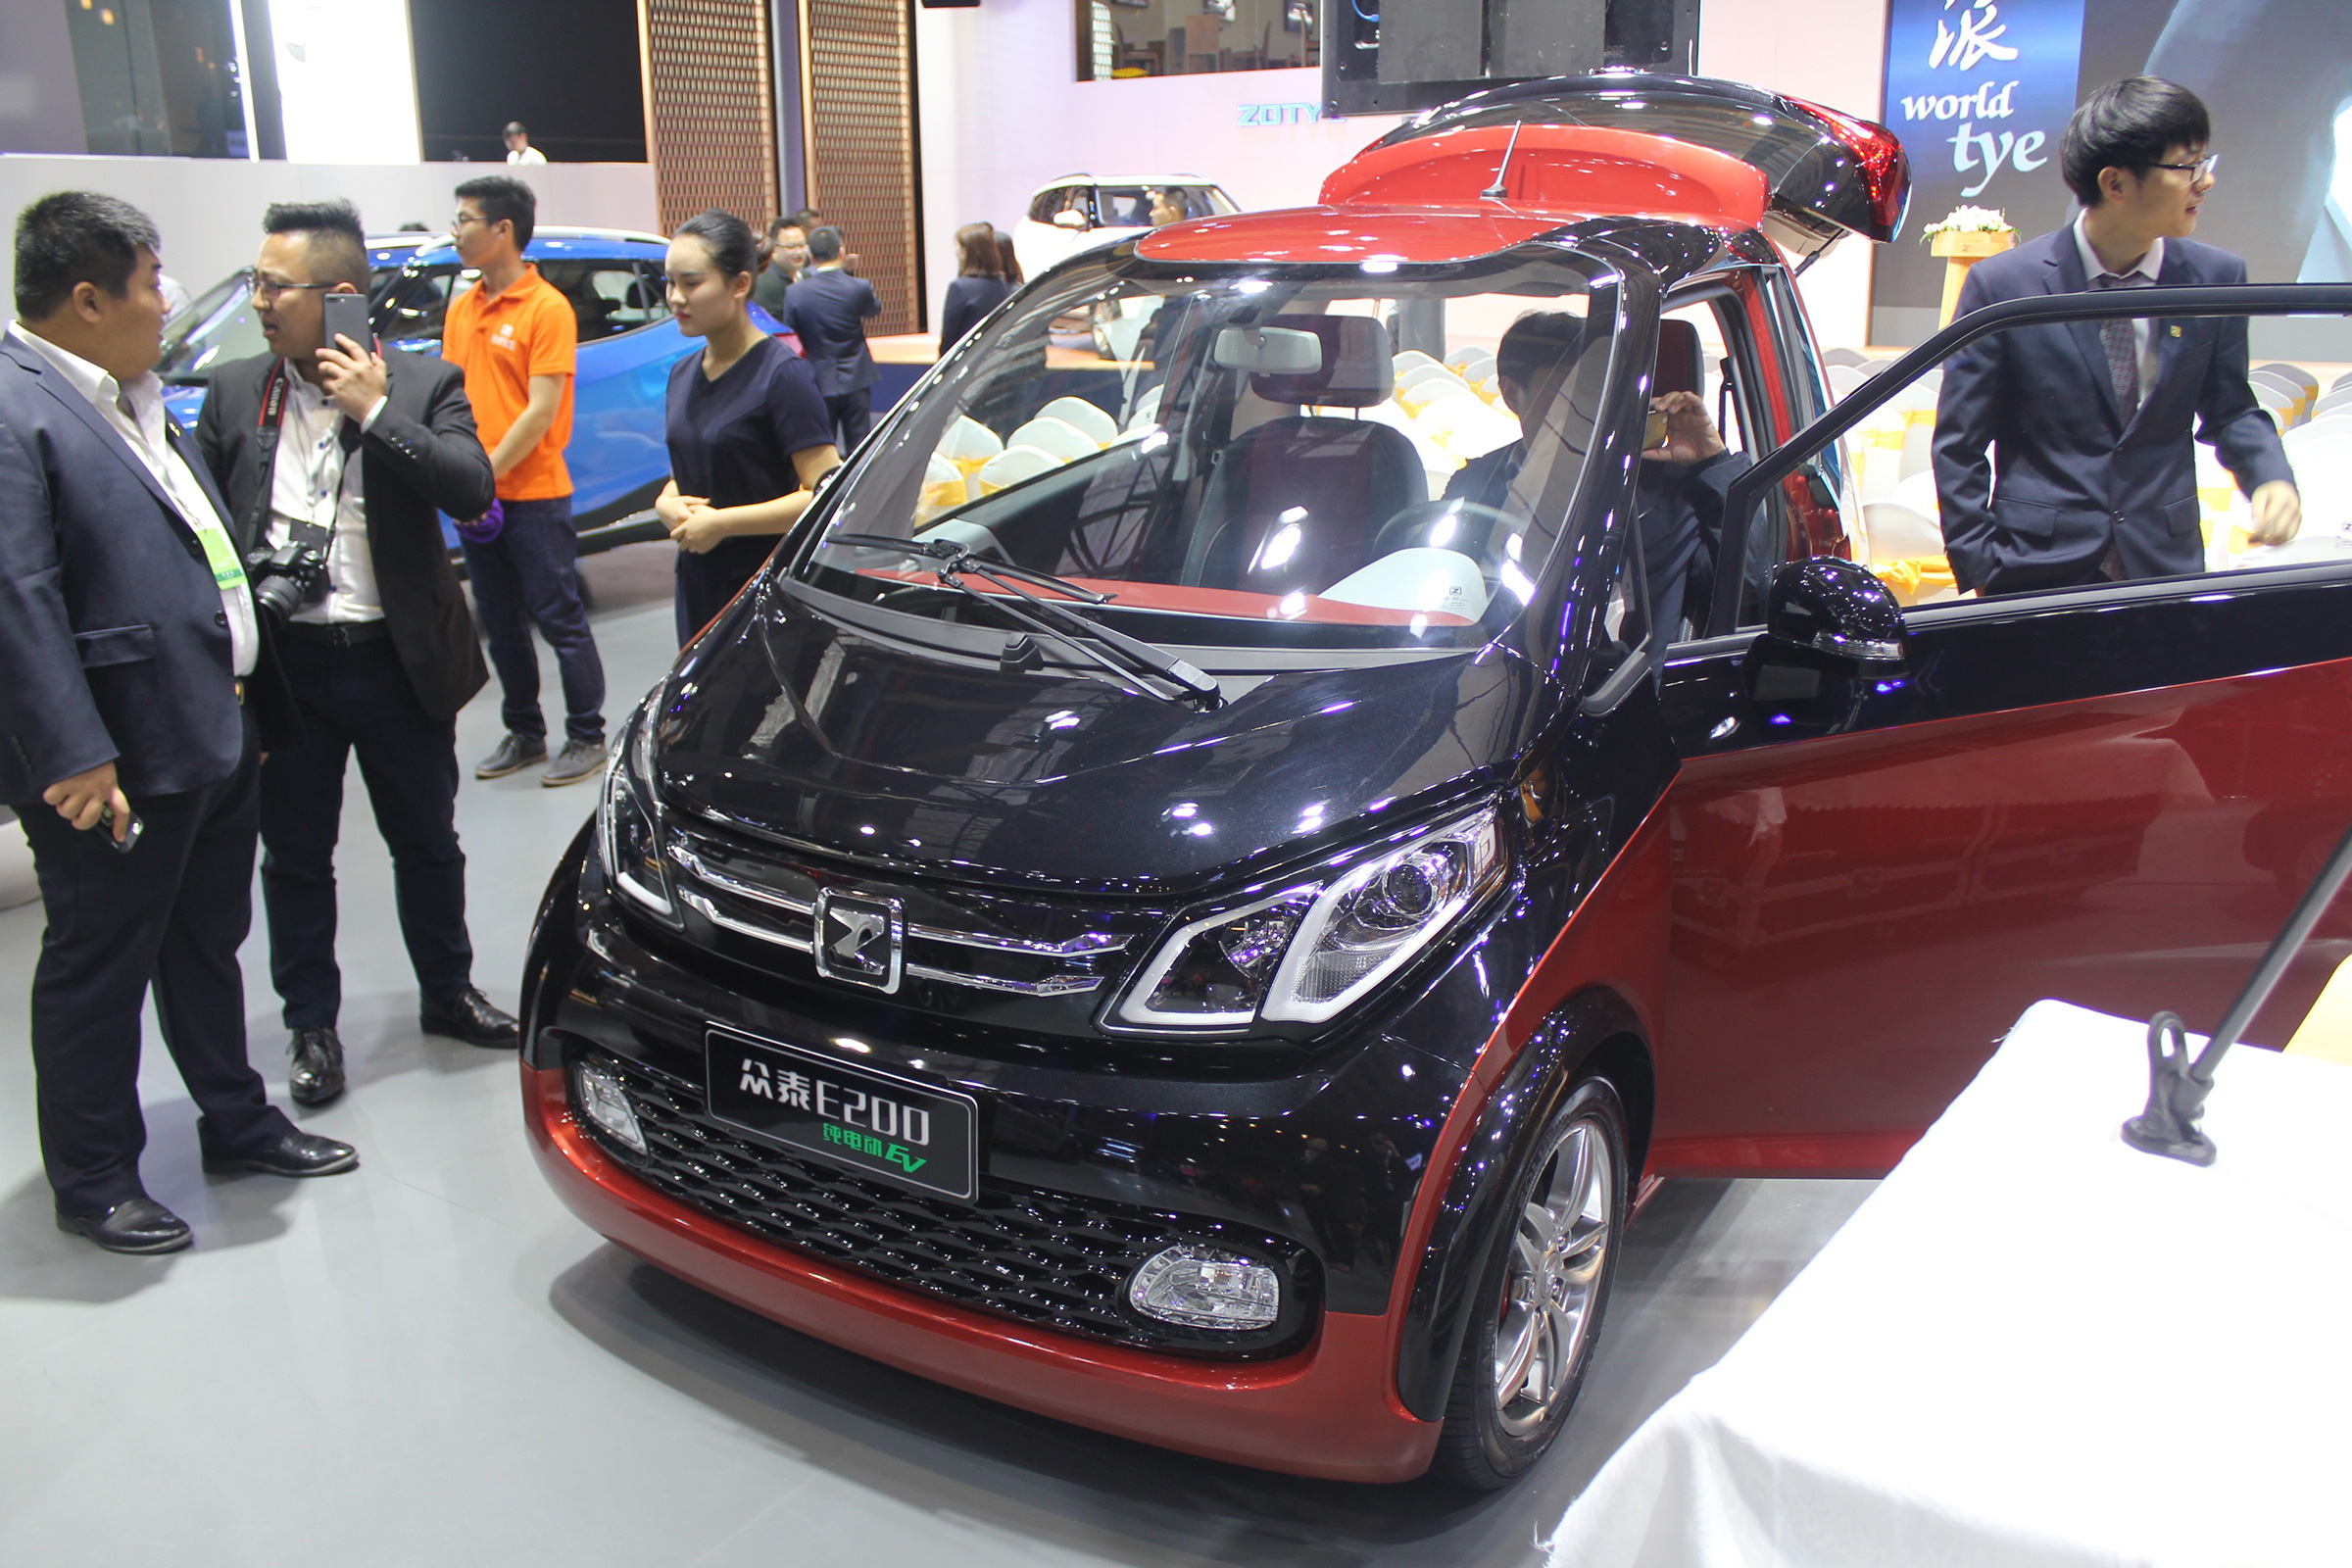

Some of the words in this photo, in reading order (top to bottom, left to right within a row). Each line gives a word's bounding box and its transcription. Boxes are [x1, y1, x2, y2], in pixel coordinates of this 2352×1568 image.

[1237, 102, 1348, 126] ZOTY
[1900, 80, 2020, 121] world
[1946, 122, 2048, 197] tye
